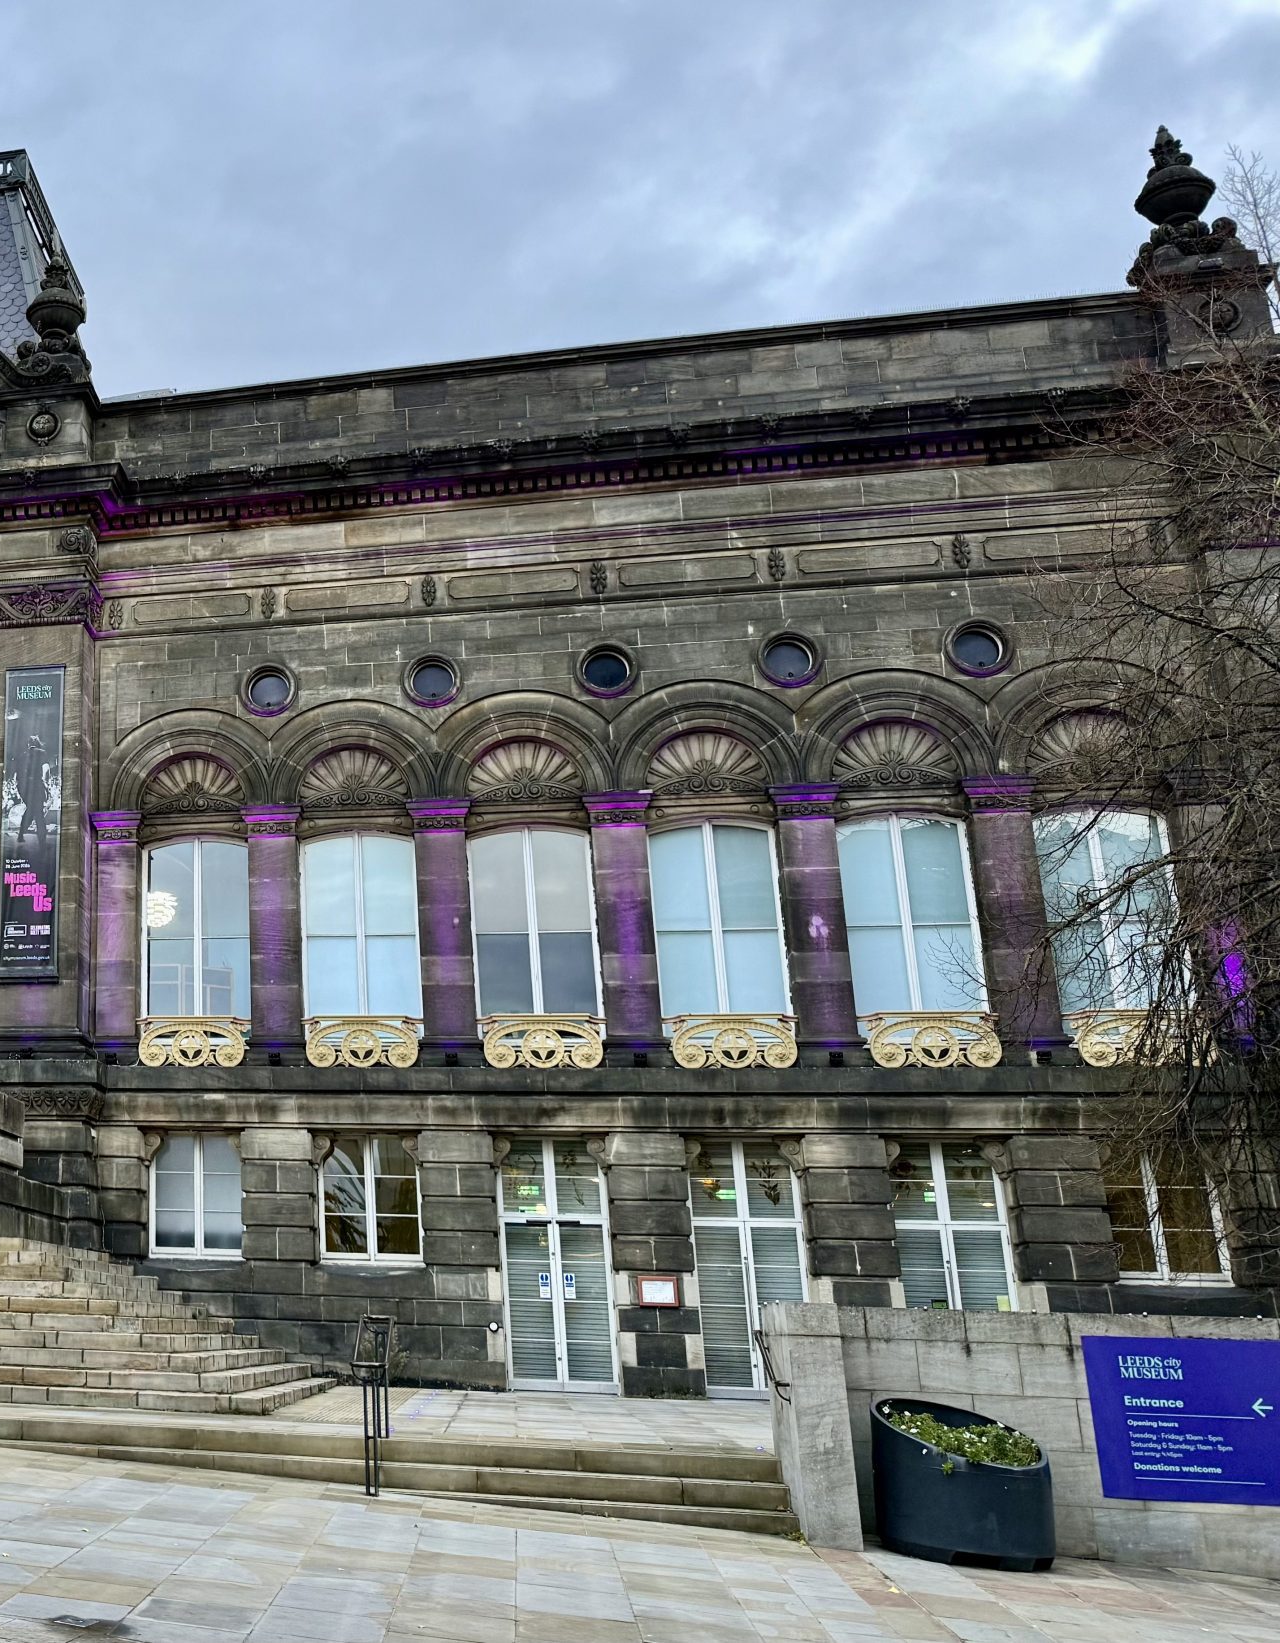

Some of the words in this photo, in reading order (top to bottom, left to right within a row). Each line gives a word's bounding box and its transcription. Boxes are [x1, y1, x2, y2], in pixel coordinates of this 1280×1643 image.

[17, 685, 41, 693] LEEDS
[17, 691, 51, 700] MUSEUM
[4, 871, 37, 884] Music
[10, 882, 47, 898] Leeds
[33, 896, 53, 912] Us
[1118, 1355, 1163, 1367] LEEDS
[1163, 1357, 1182, 1369] city
[1120, 1366, 1184, 1380] MUSEUM
[1123, 1395, 1184, 1408] Entrance
[1127, 1419, 1157, 1428] Opening
[1129, 1431, 1157, 1440] Tuesday
[1207, 1434, 1224, 1442] 5pm
[1130, 1440, 1162, 1450] Saturday
[1217, 1444, 1234, 1452] 5pm
[1133, 1462, 1180, 1472] Donations
[1181, 1465, 1222, 1474] welcome
